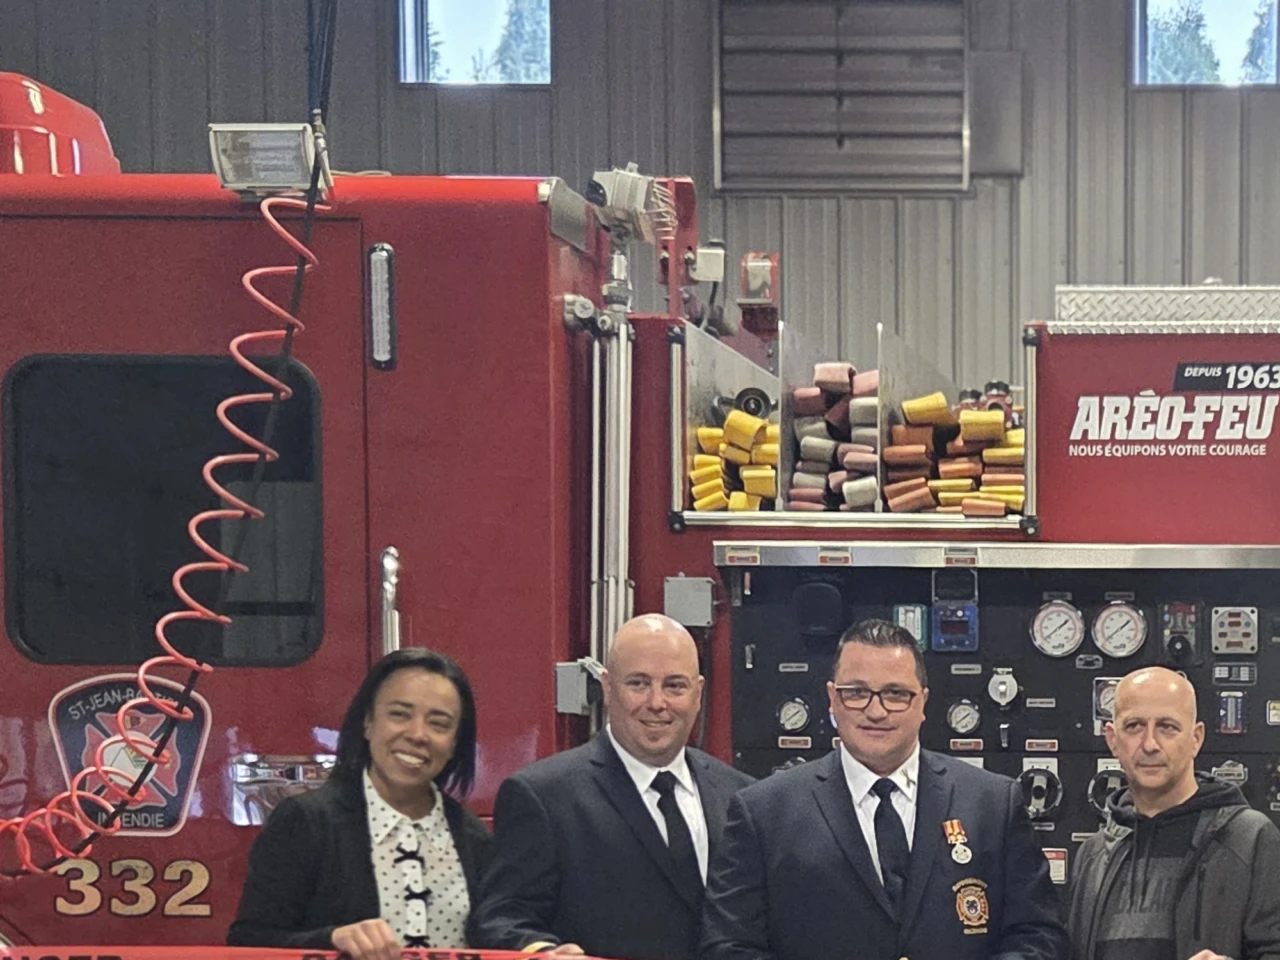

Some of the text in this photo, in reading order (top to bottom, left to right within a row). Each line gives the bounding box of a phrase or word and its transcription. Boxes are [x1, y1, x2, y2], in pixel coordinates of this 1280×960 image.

[1184, 366, 1222, 378] DEPUIS
[1068, 442, 1267, 458] NOUS ÉQUIPONS VOTRE COURAGE
[68, 687, 184, 720] ST-JEAN-B
[98, 811, 165, 828] INENDIE
[55, 858, 212, 917] 332
